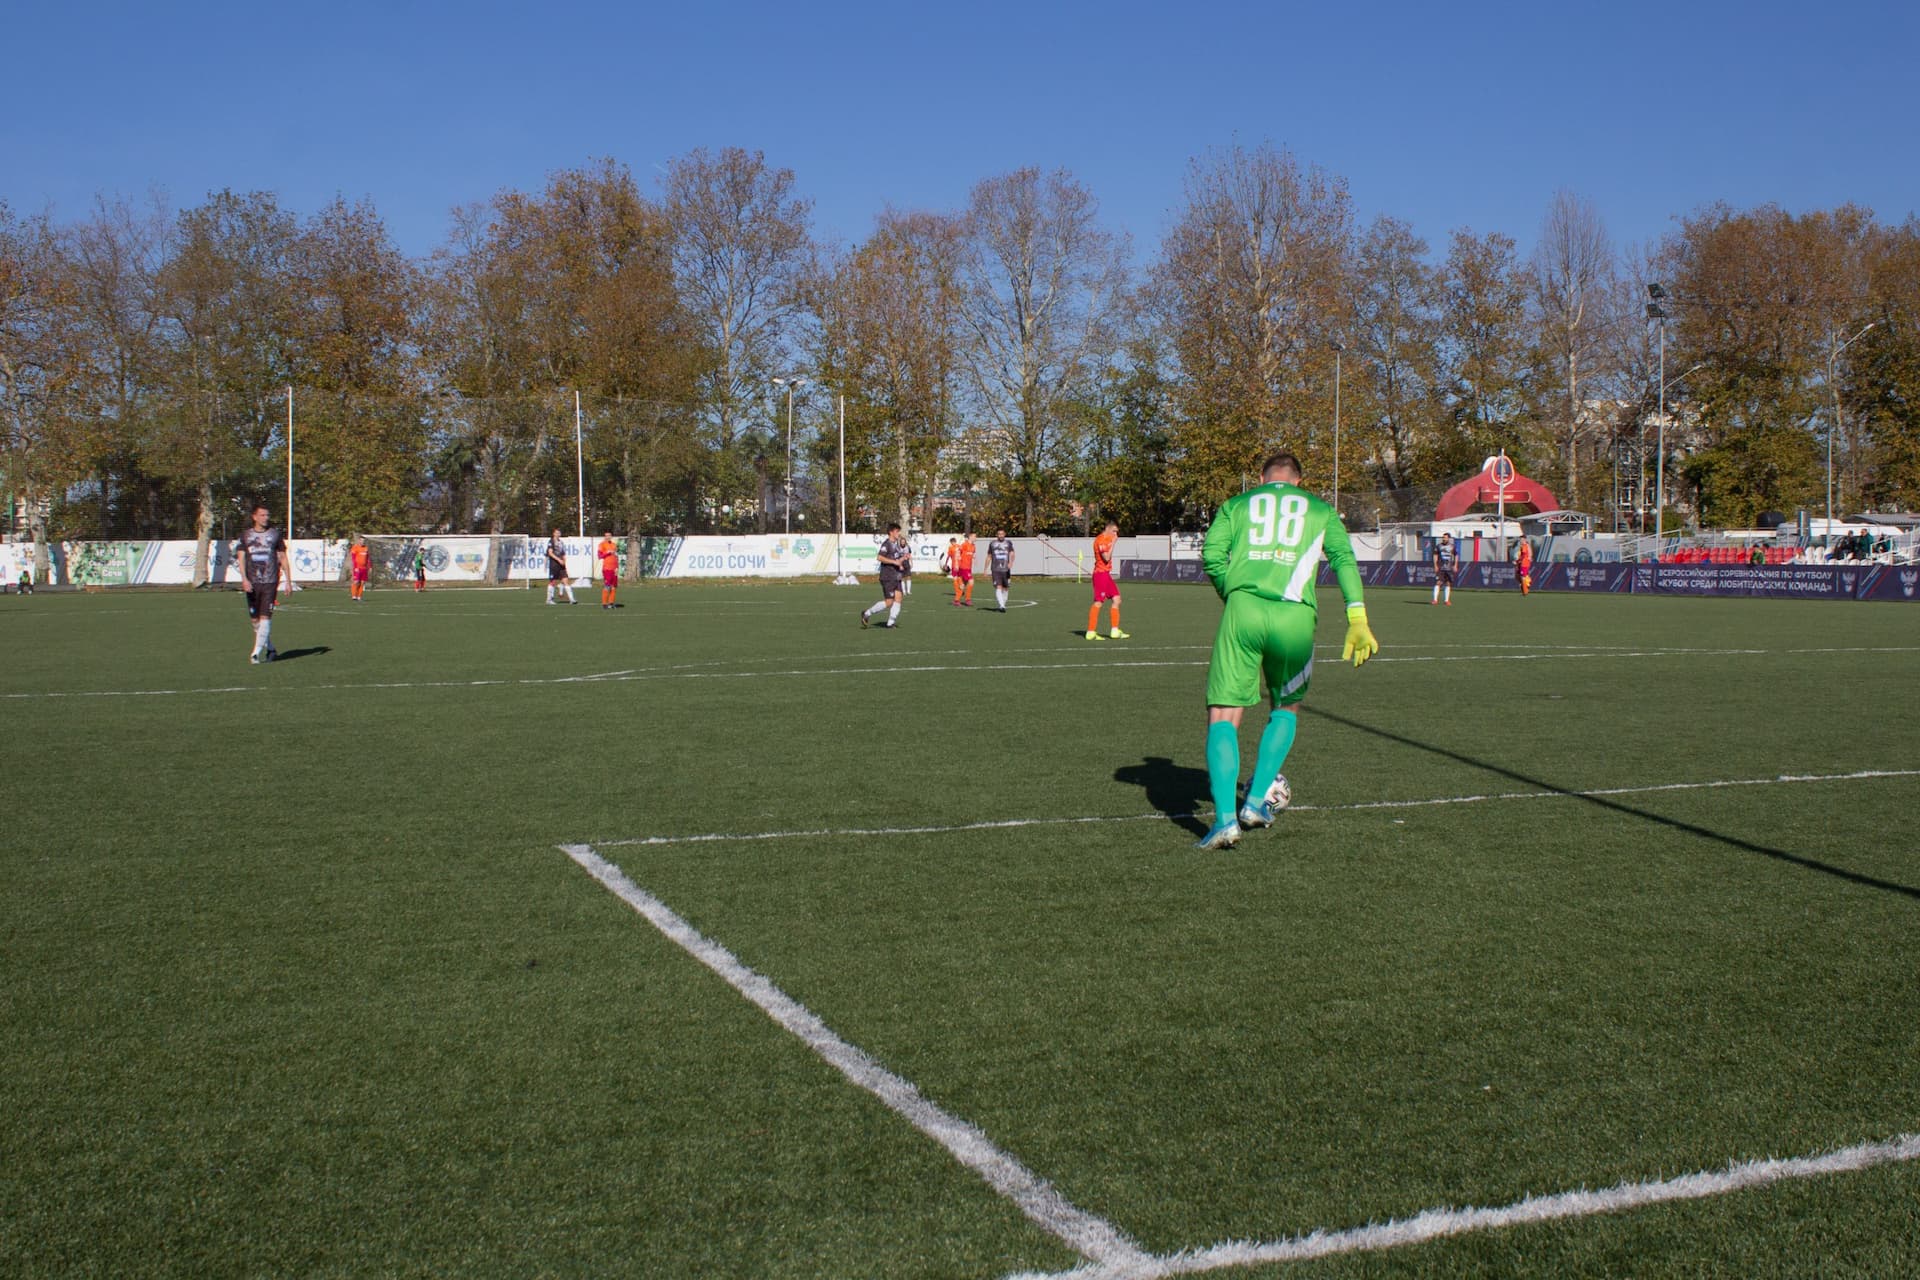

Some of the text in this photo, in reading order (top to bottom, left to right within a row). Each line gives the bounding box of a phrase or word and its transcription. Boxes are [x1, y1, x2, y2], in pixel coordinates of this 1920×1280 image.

[1249, 493, 1309, 546] 98
[688, 555, 724, 569] 2020
[728, 554, 766, 569] СОЧИ
[1658, 568, 1719, 577] ВСЕРОССИЙСКИЕ
[1781, 571, 1793, 579] ПО
[1794, 571, 1833, 579] ФУТБОЛУ
[1690, 580, 1717, 589] СРЕДИ
